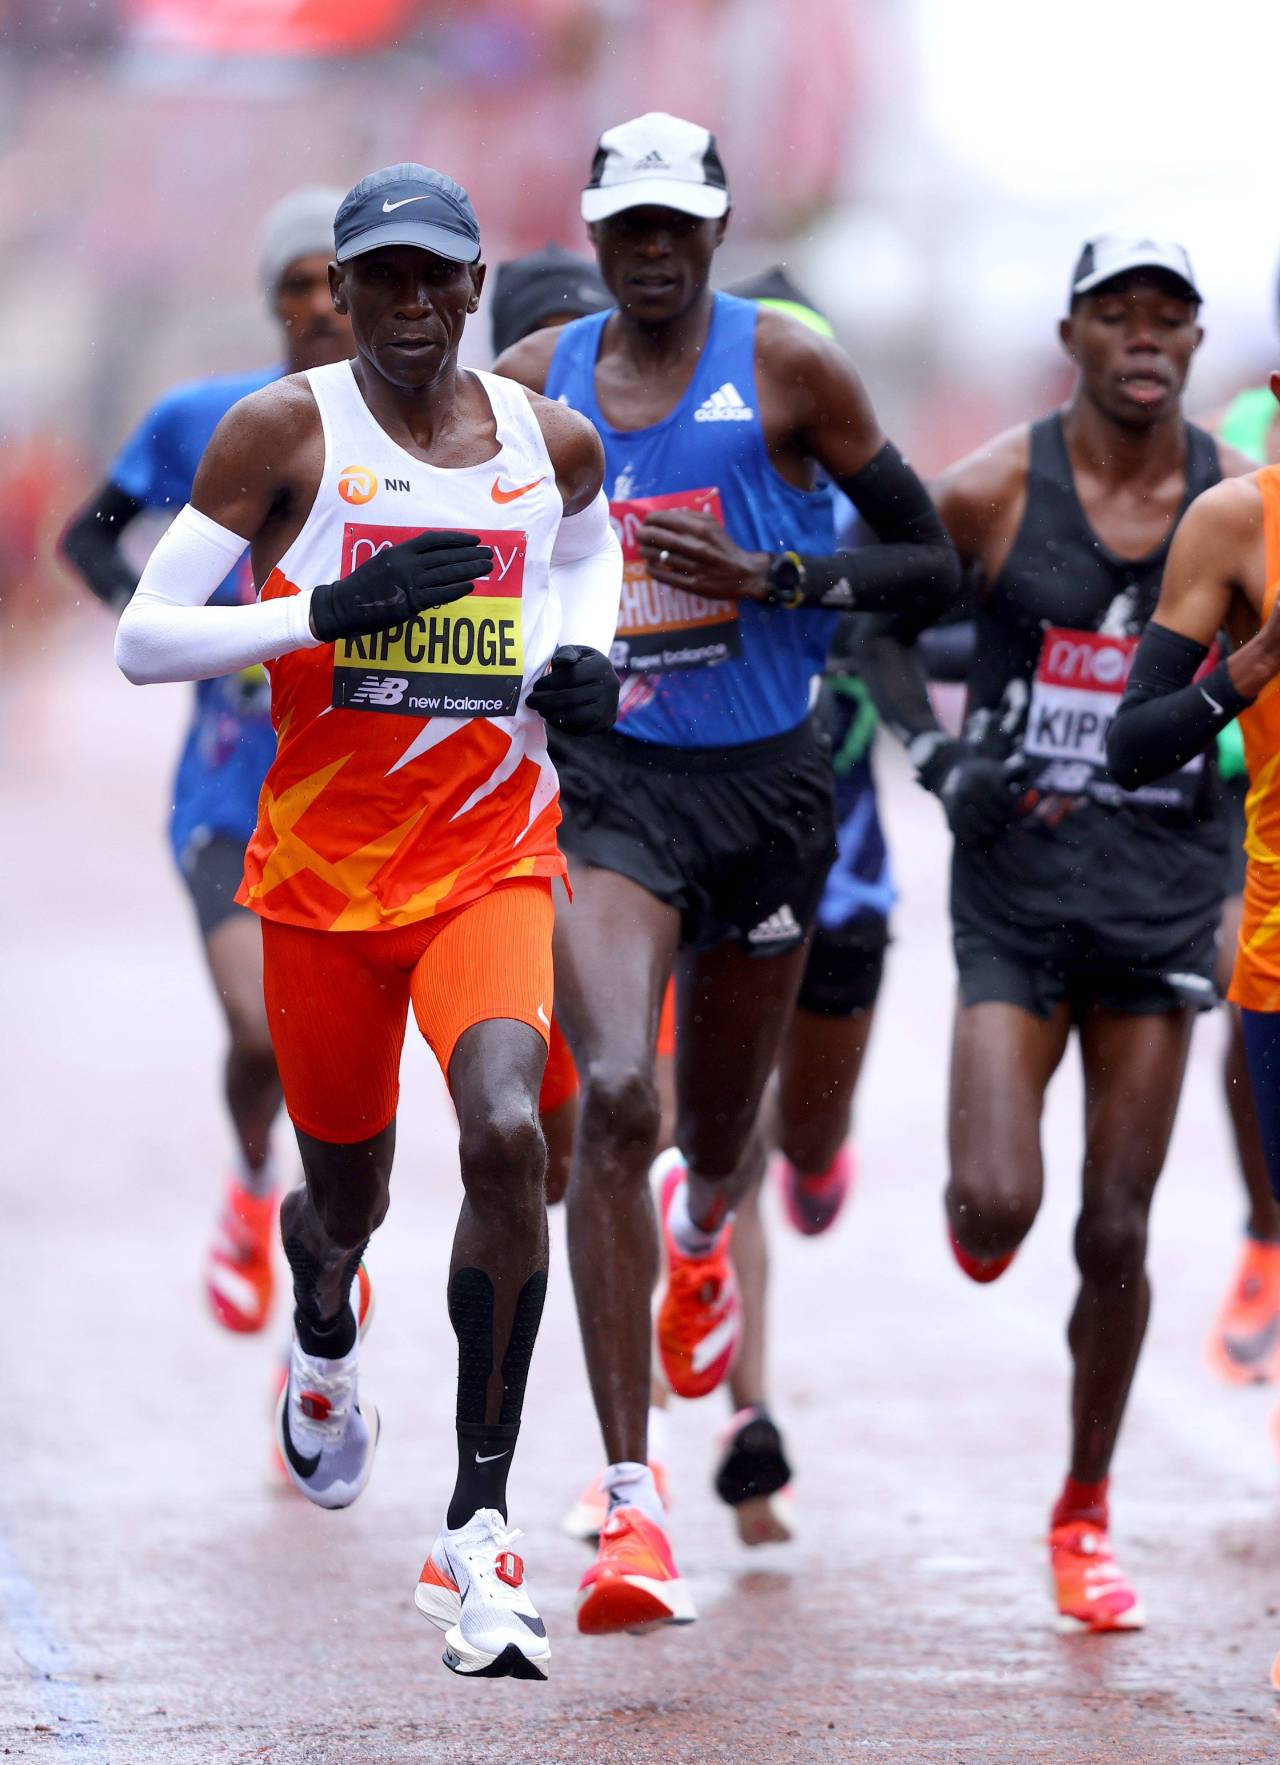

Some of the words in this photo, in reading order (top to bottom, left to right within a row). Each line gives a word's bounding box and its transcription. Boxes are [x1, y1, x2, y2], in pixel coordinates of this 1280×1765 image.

[384, 478, 411, 492] NN
[408, 695, 442, 709] new
[443, 695, 503, 711] balance
